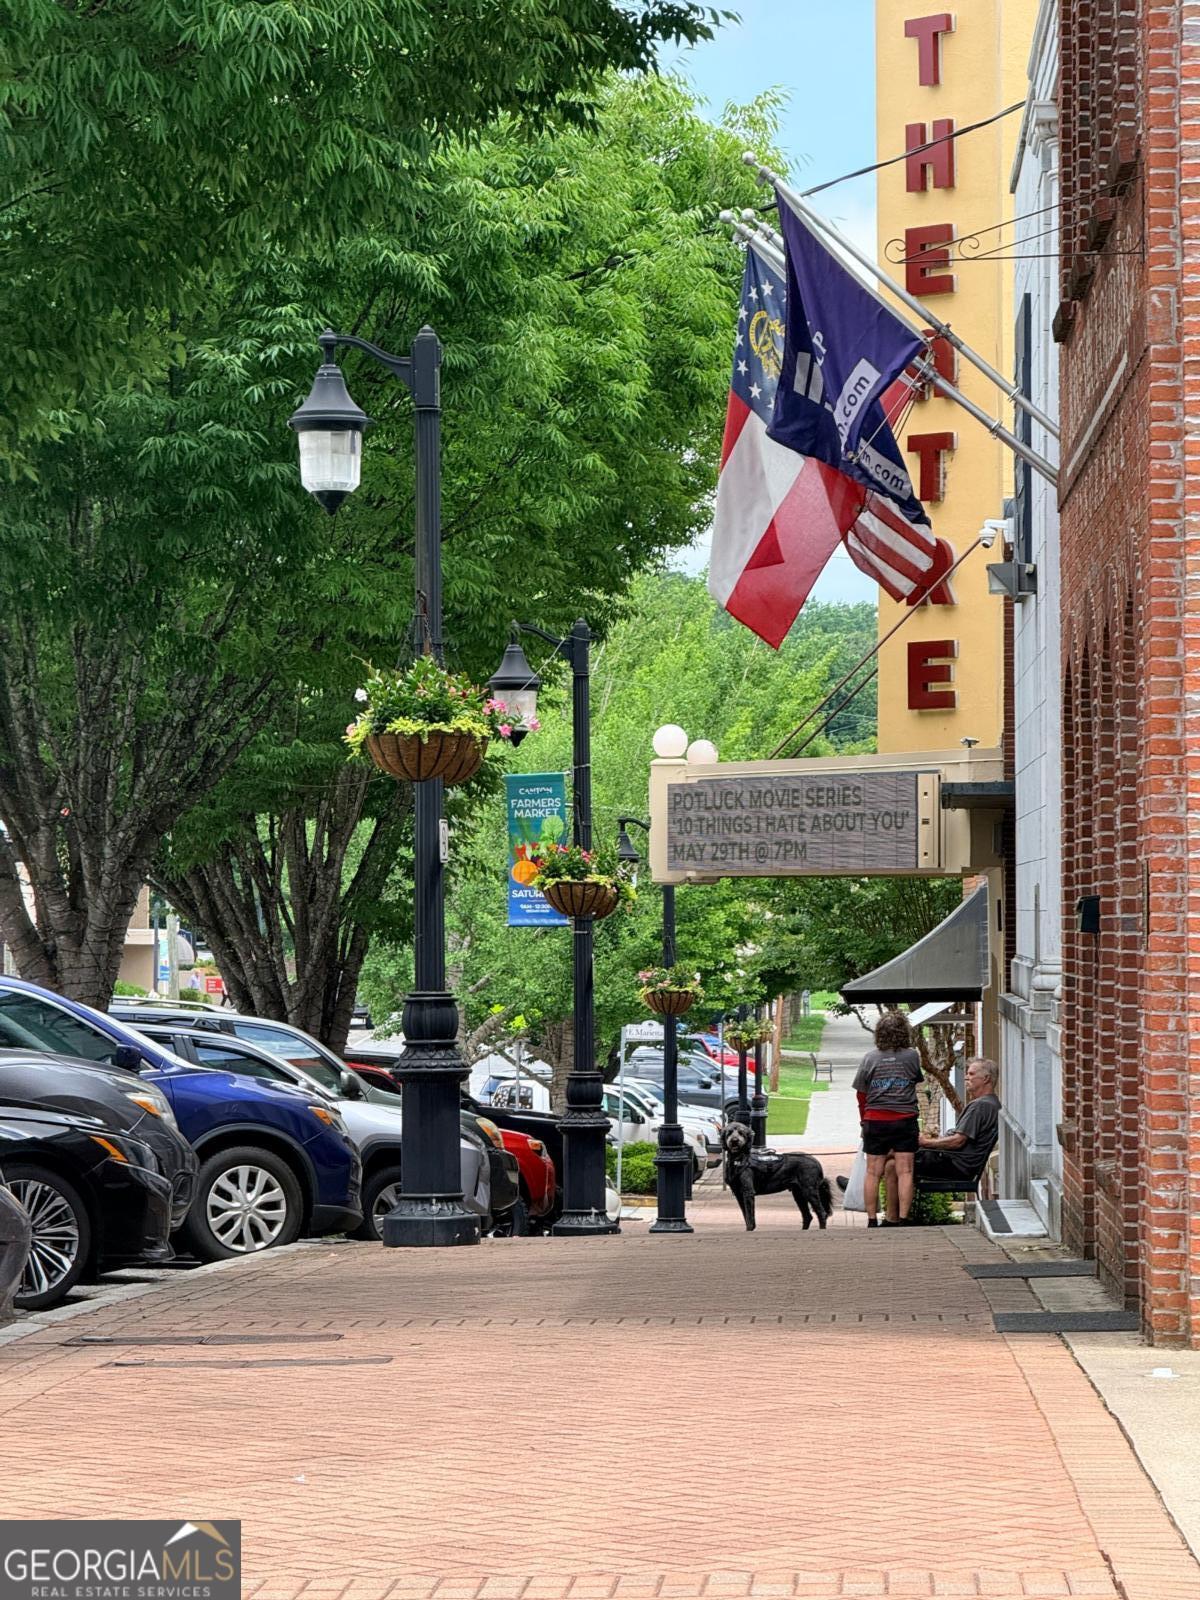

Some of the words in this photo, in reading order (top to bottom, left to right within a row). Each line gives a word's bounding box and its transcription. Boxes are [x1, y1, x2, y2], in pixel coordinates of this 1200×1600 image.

[903, 12, 957, 711] THEATRE
[510, 797, 561, 809] FARMERS
[673, 790, 745, 811] POTLUCK
[749, 788, 800, 809] MOVIE
[805, 785, 862, 807] SERIES
[514, 807, 560, 819] MARKET
[697, 815, 752, 835] THINGS
[756, 815, 761, 834] I
[766, 814, 807, 833] HATE
[811, 811, 866, 832] ABOUT
[673, 842, 707, 861] MAY
[711, 841, 749, 861] 29TH
[755, 841, 769, 863] @
[774, 839, 807, 860] 7PM
[511, 889, 545, 898] SATUR
